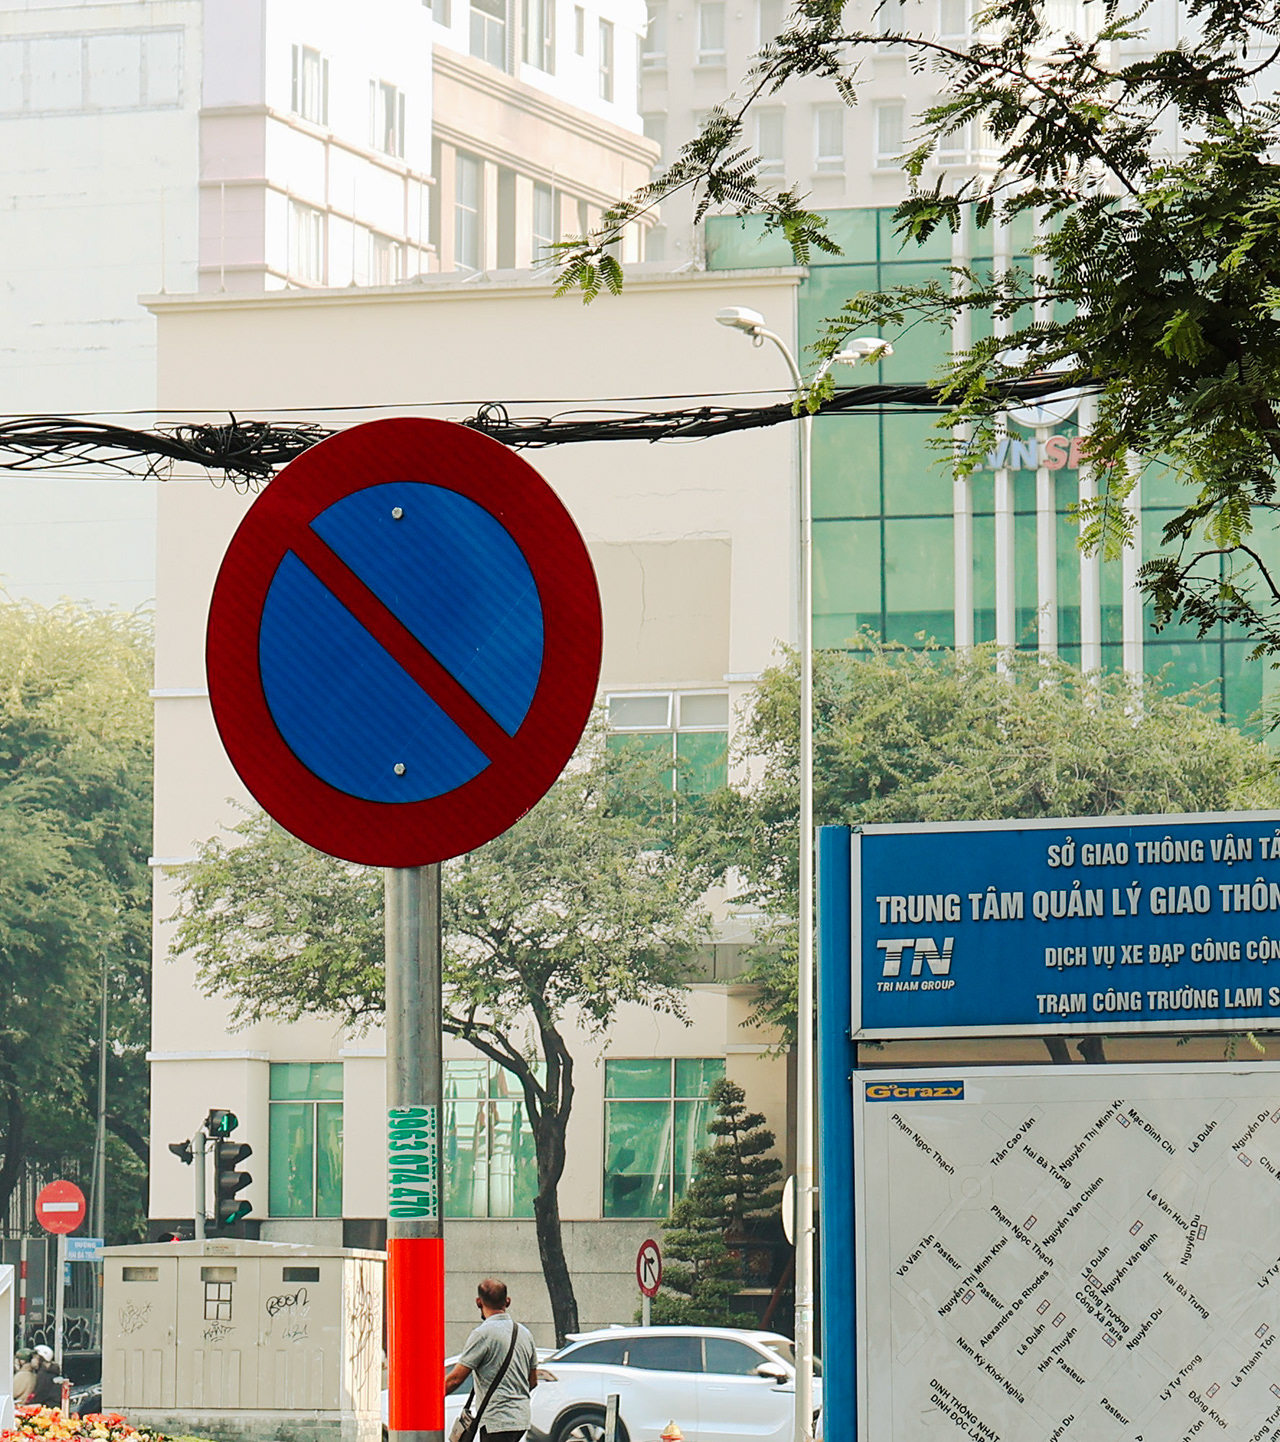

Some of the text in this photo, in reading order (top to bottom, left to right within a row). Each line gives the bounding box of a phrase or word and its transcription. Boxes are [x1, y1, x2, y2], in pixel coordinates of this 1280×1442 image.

[1048, 836, 1074, 867] SỞ
[1082, 843, 1128, 866] GIAO
[1135, 836, 1204, 863] THÔNG
[1210, 834, 1252, 865] VẬN
[876, 893, 960, 923] TRUNG
[968, 886, 1024, 920] TÂM
[1032, 880, 1103, 920] QUẢN
[1112, 881, 1141, 915] LÝ
[1150, 885, 1211, 914] GIAO
[877, 937, 954, 977] TN
[1045, 947, 1087, 971] DỊCH
[1092, 945, 1115, 969] VỤ
[1121, 945, 1143, 964] XE
[1149, 942, 1184, 968] ĐẠP
[1191, 938, 1240, 962] CÔNG
[877, 979, 955, 992] TRI NAM GROUP
[1037, 993, 1087, 1017] TRẠM
[1092, 988, 1142, 1012] CÔNG
[1147, 984, 1219, 1010] TRƯỜNG
[1224, 988, 1262, 1008] LAM
[930, 1150, 955, 1175] Thạch
[933, 1239, 962, 1271] Pasteur
[976, 1282, 1004, 1311] Pasteur
[1056, 1357, 1085, 1386] Pasteur
[1100, 1398, 1130, 1426] Pasteur
